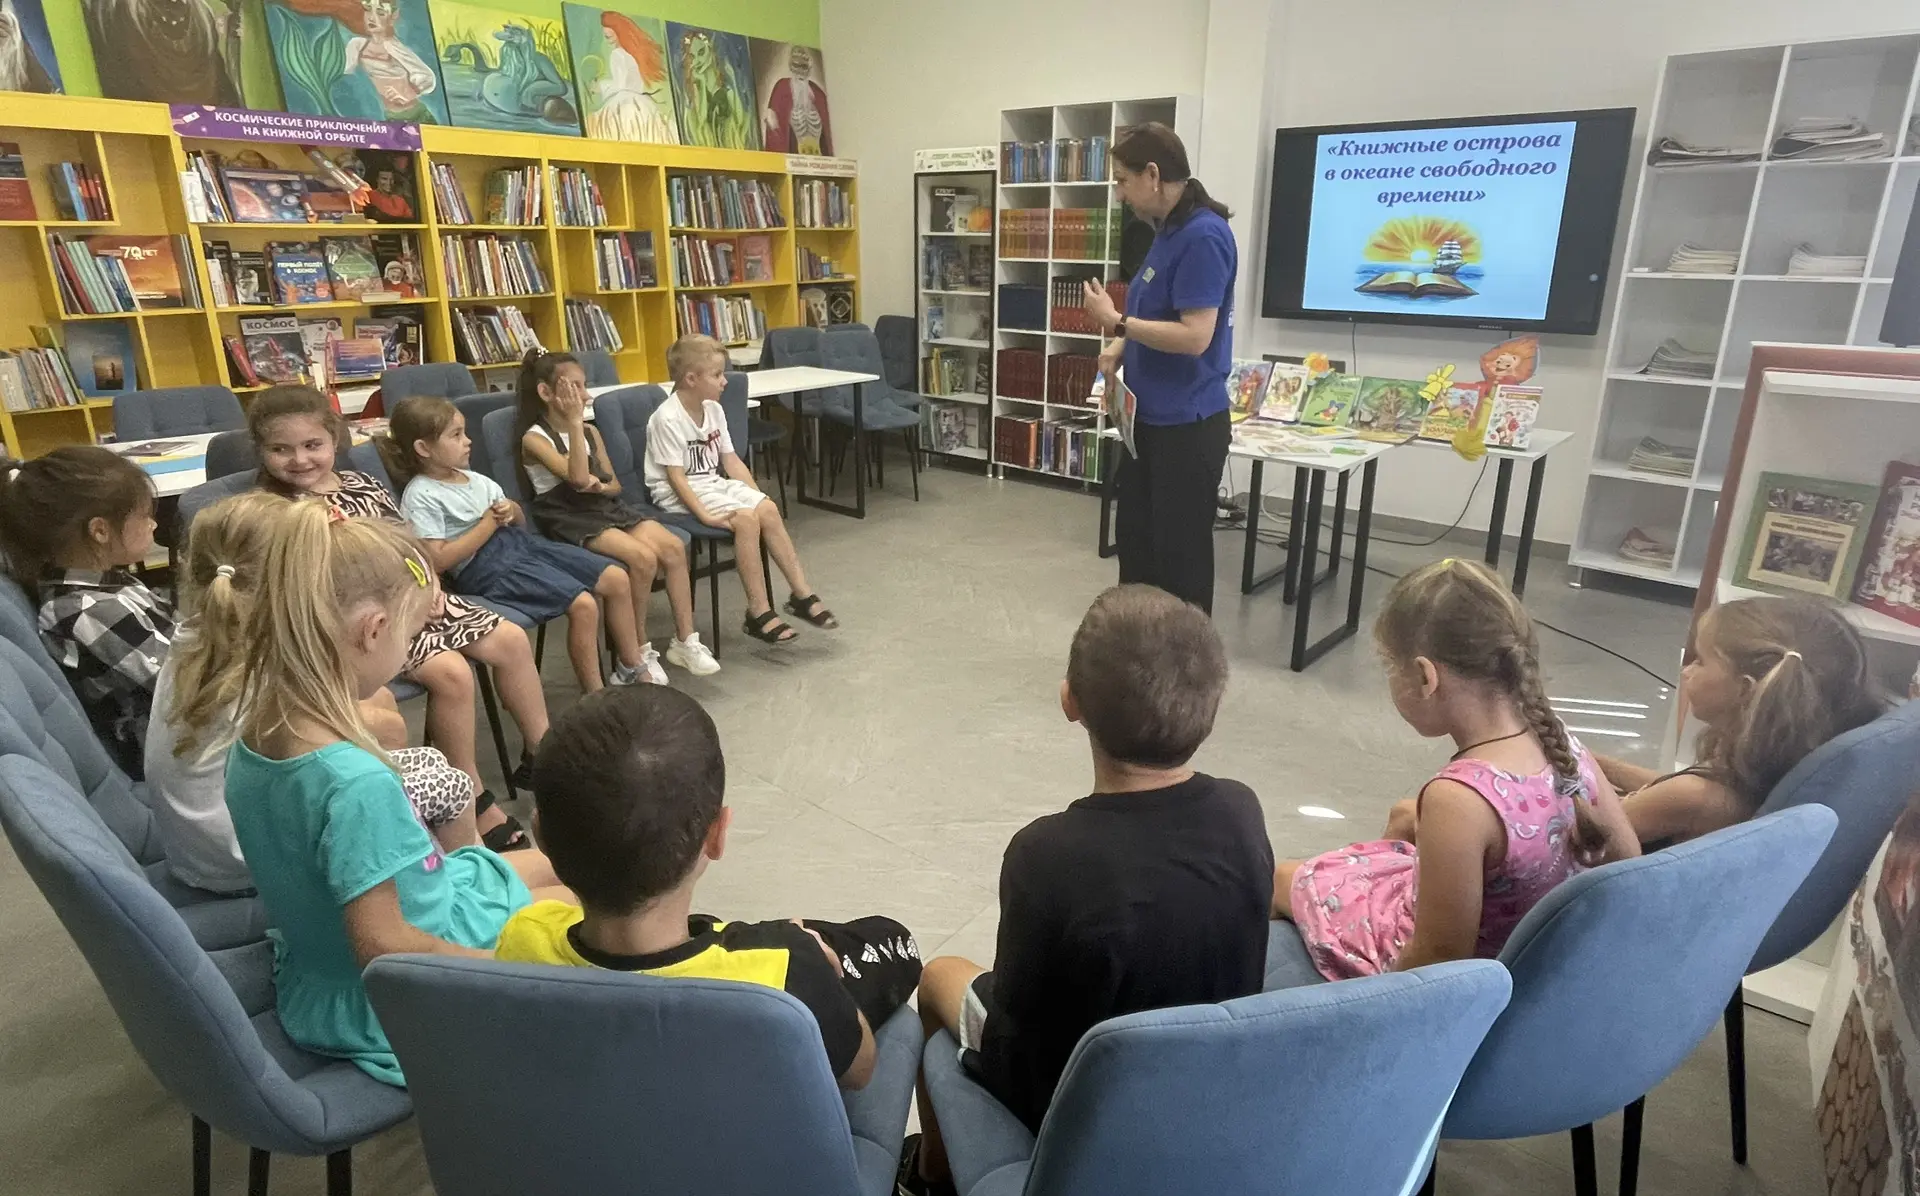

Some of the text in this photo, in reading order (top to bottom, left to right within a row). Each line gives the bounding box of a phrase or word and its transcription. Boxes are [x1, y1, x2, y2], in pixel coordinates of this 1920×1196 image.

[215, 111, 387, 134] КОСМИЧЕСКИЕ ПРИКЛЮЧЕНИЯ
[243, 126, 365, 144] НА КНИЖНОЙ ОРБИТЕ
[1328, 133, 1562, 156] «Книжные острова
[1325, 158, 1557, 181] в океане свободного
[1377, 189, 1486, 207] времени»
[246, 320, 296, 330] КОСМОС
